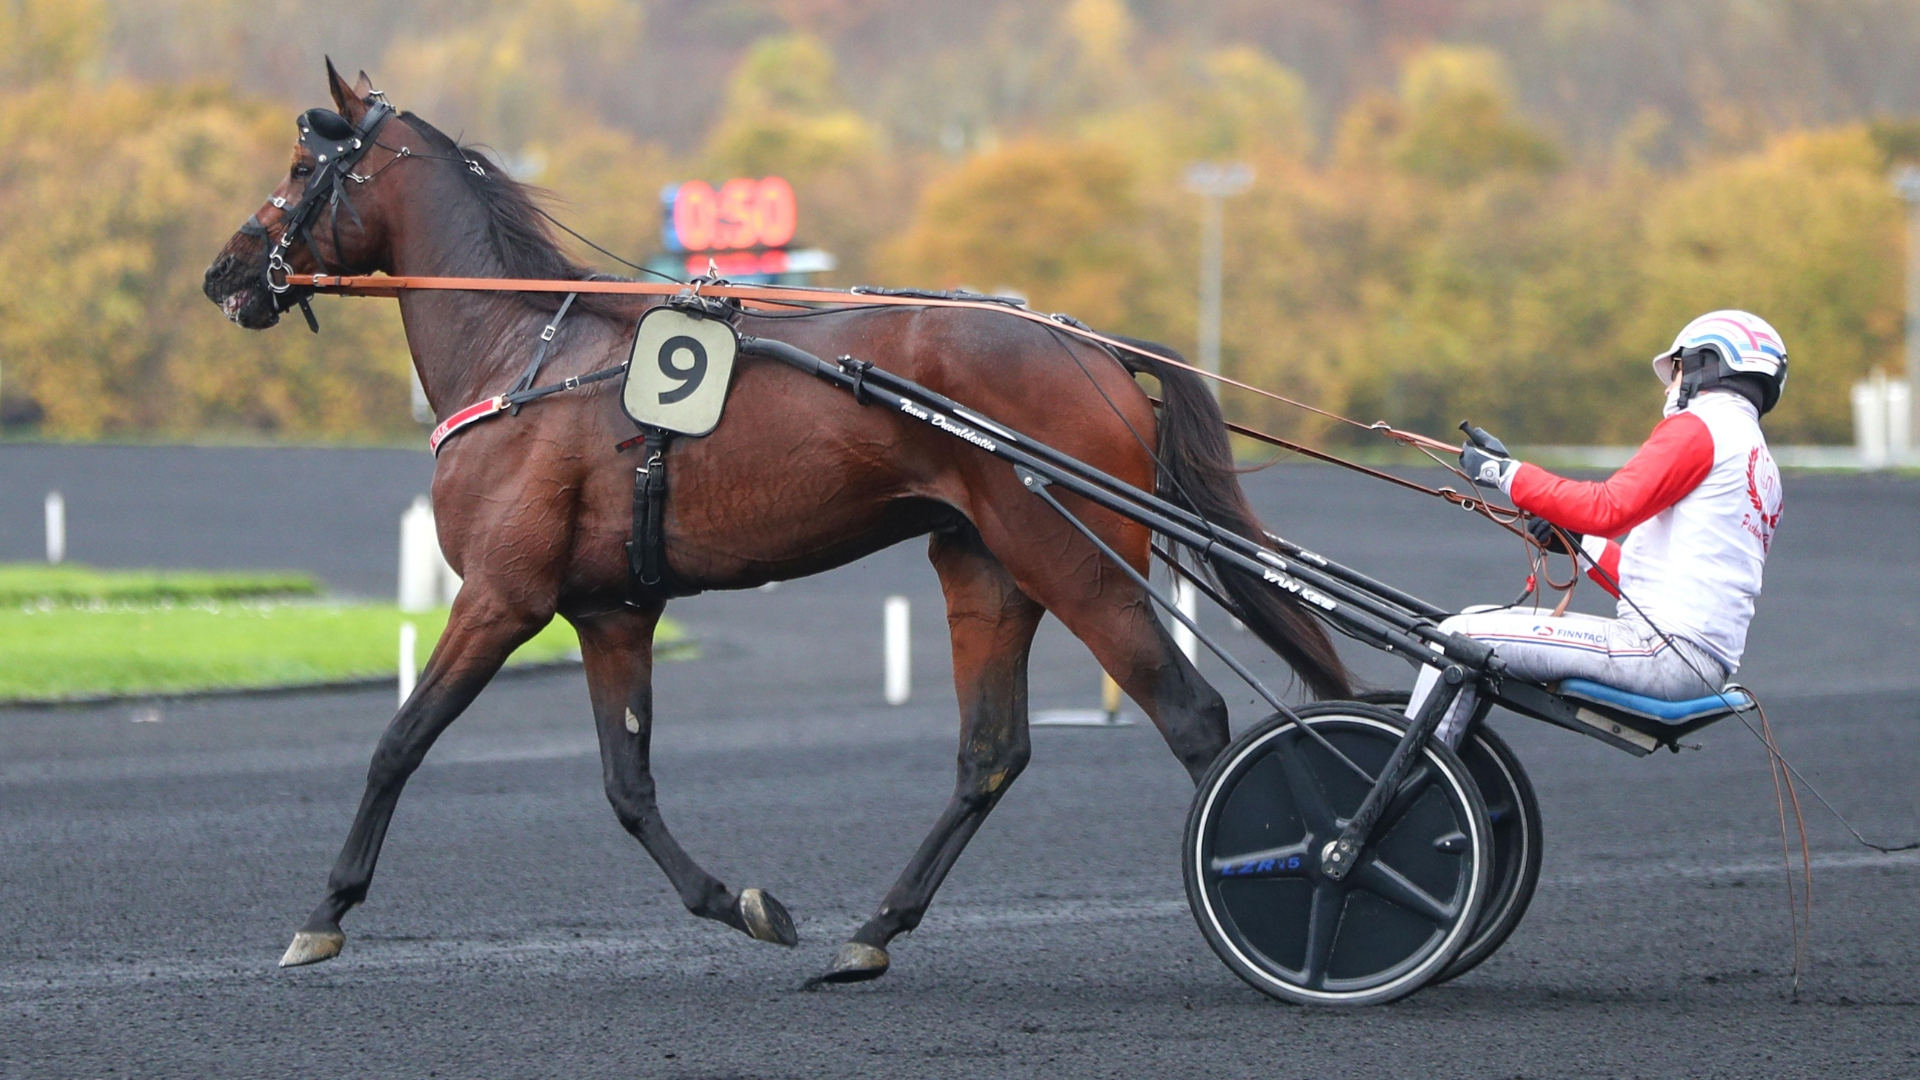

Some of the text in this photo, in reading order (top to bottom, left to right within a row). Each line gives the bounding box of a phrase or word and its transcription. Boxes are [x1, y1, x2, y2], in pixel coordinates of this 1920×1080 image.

[658, 335, 708, 405] 9
[900, 398, 996, 451] Team Duvaldestin
